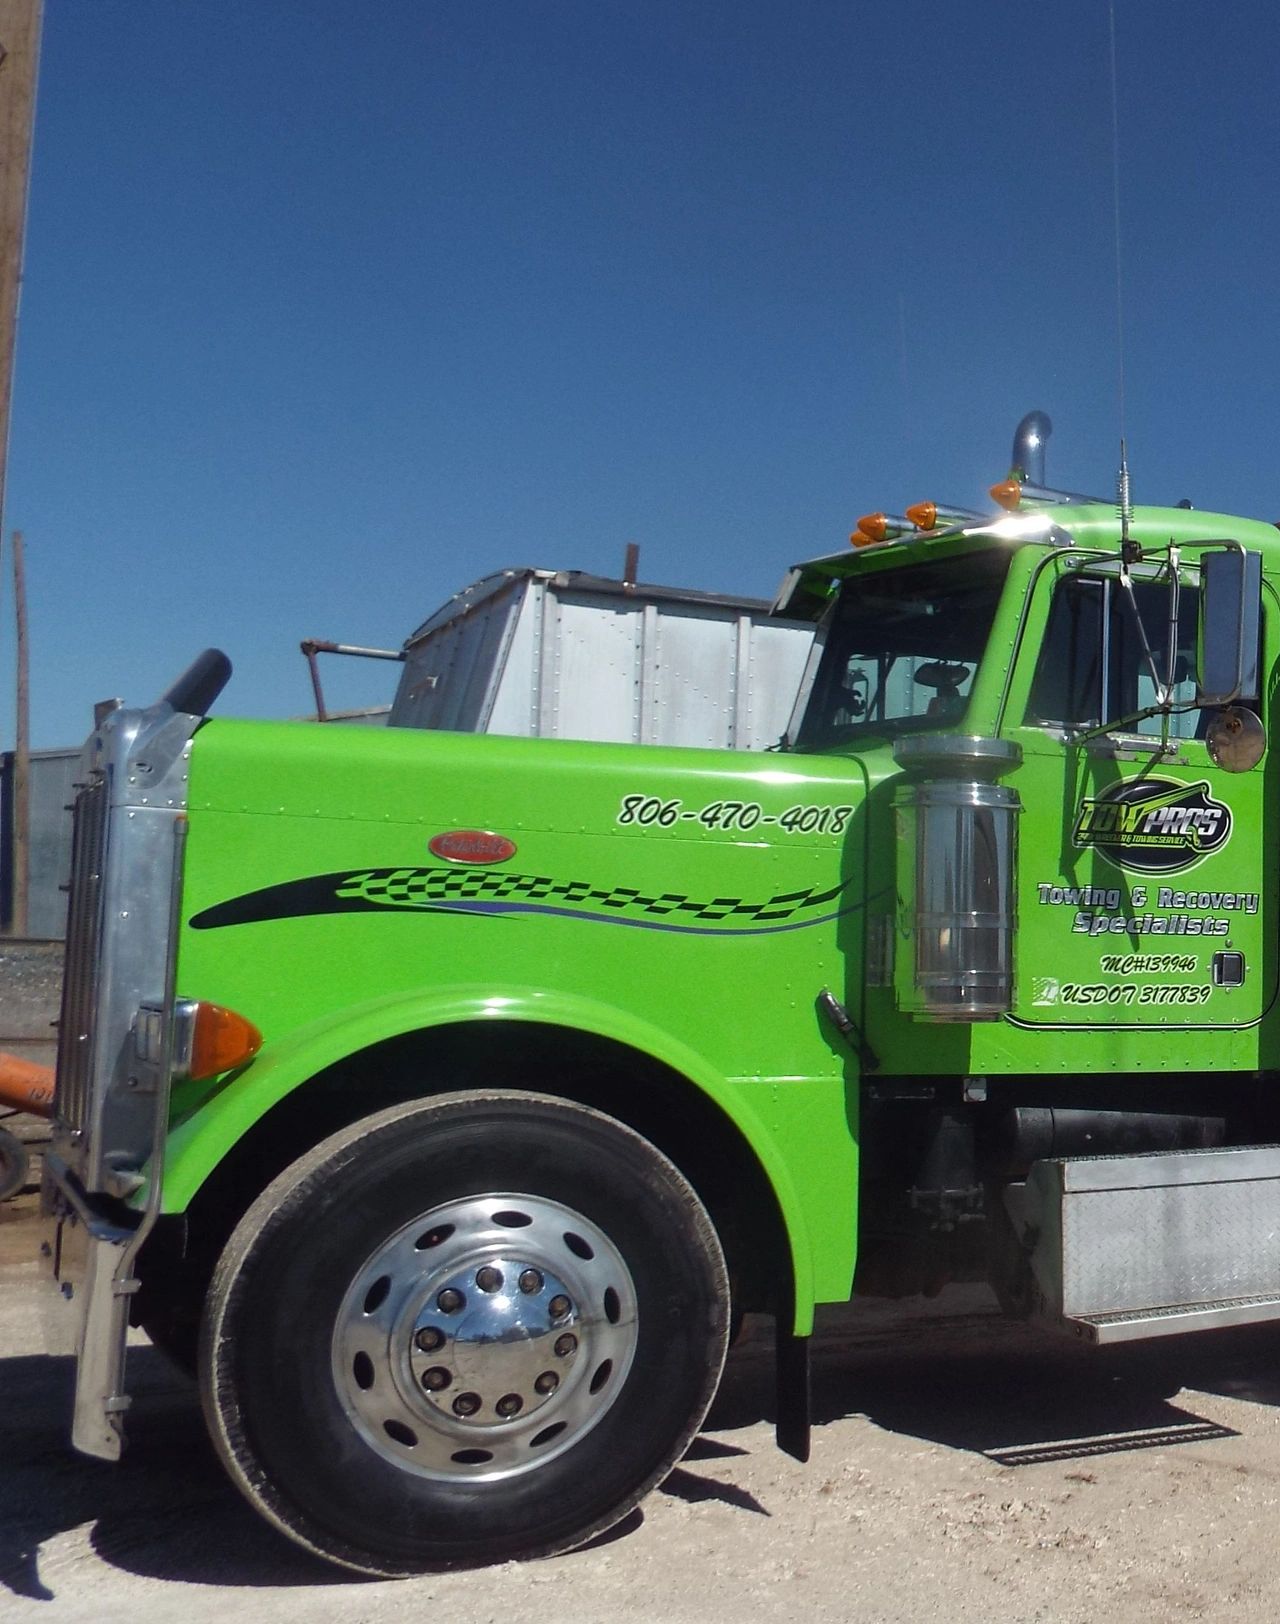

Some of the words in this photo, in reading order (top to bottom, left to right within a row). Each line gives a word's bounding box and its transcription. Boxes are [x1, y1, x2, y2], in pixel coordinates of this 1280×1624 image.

[618, 794, 853, 834] 806-470-4018
[1143, 807, 1222, 835] PROS
[1037, 883, 1121, 910] Towing
[1131, 886, 1148, 908] &
[1157, 887, 1260, 914] Recovery
[1071, 911, 1230, 937] Specialists
[1100, 954, 1197, 975] MC#139946
[1061, 983, 1136, 1005] USDOT
[1138, 984, 1212, 1006] 3177839
